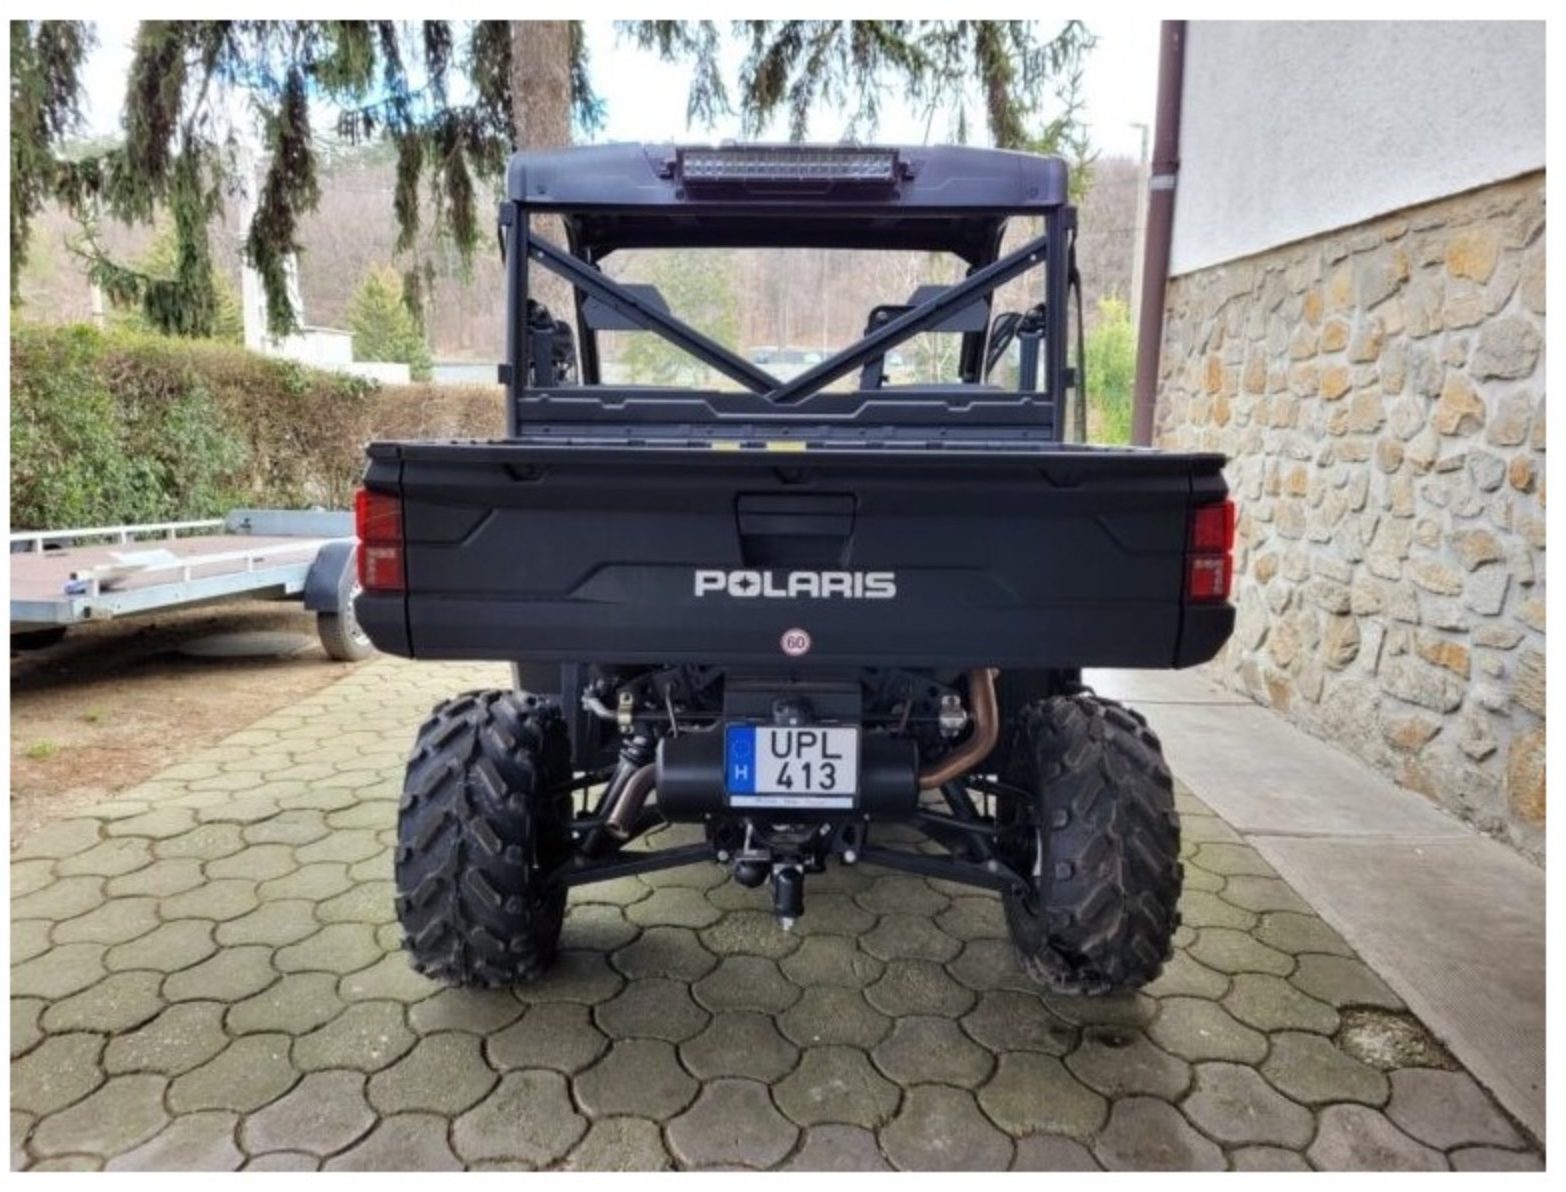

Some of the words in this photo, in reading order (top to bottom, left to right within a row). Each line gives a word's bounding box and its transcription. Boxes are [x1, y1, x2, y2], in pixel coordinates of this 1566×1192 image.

[695, 570, 896, 598] POLARIS
[787, 635, 805, 649] 60
[771, 730, 842, 759] UPL
[735, 764, 748, 780] H
[776, 761, 836, 790] 413
